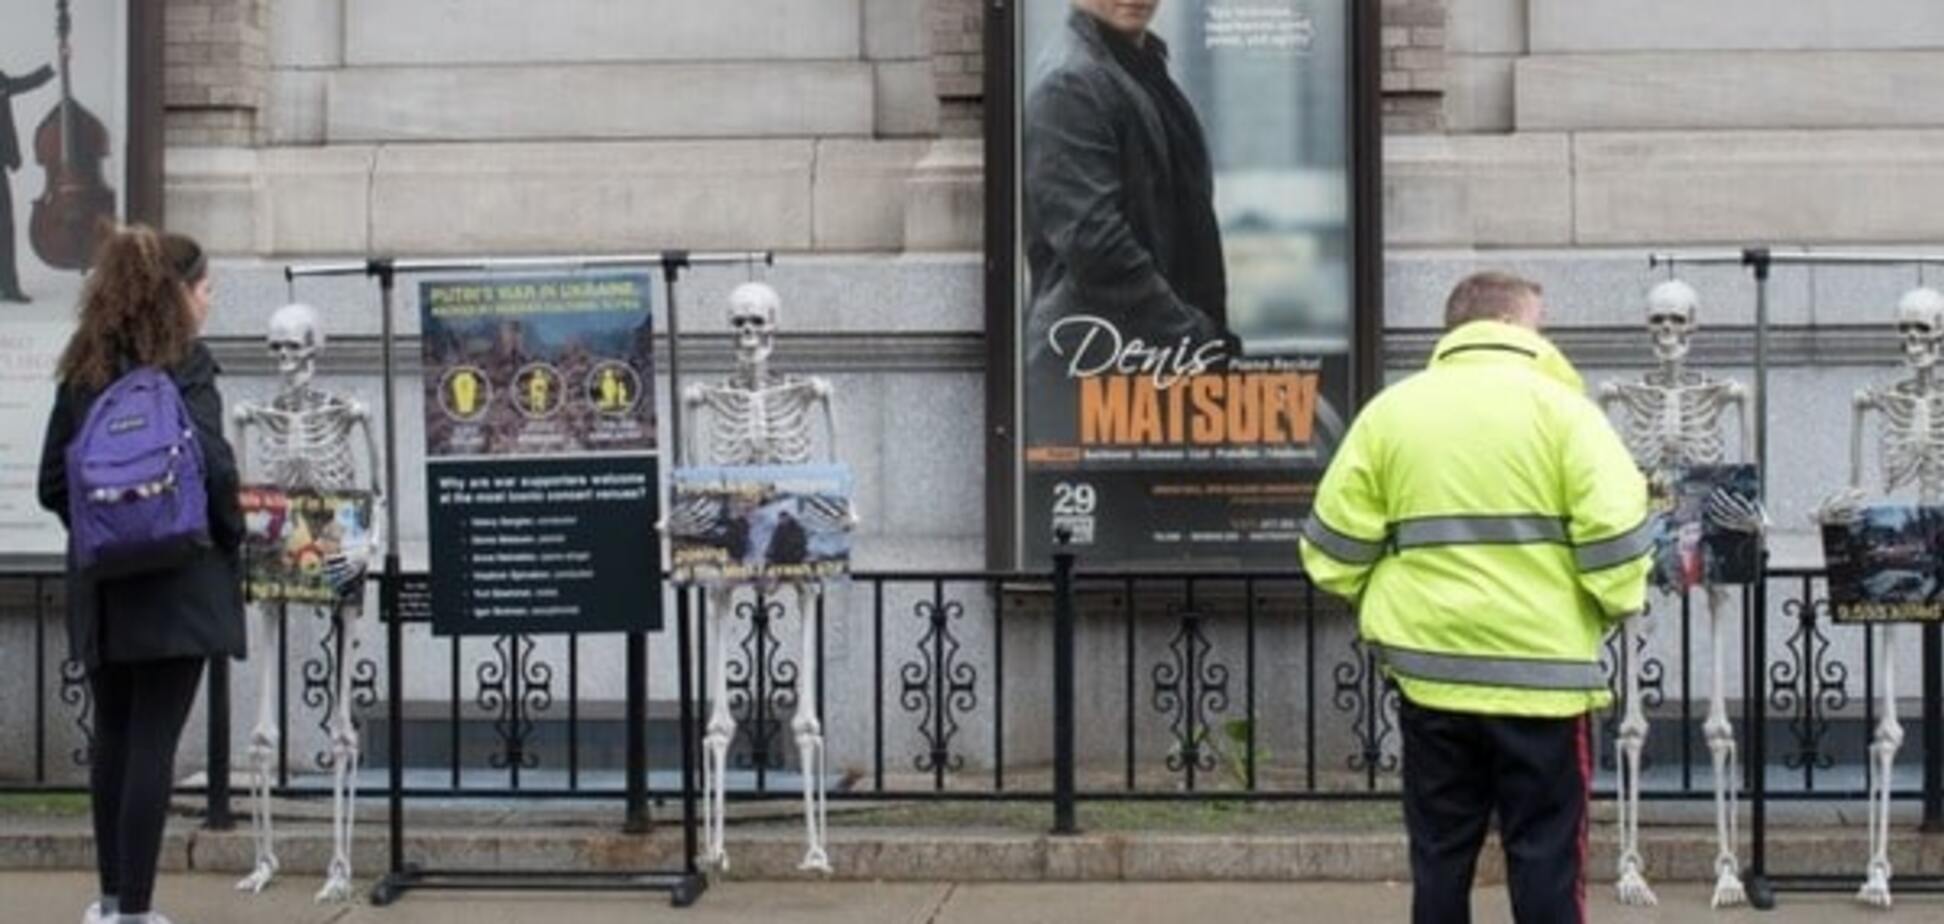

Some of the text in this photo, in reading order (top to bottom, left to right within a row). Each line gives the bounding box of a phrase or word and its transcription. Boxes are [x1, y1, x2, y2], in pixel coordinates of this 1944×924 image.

[1049, 314, 1228, 390] Denis
[1082, 374, 1319, 444] MATSUEV
[440, 474, 645, 490] Why are war supporters welcome
[453, 492, 471, 503] the
[475, 492, 505, 503] most
[548, 490, 592, 501] concert
[597, 487, 646, 500] venues?
[1052, 483, 1096, 514] 29
